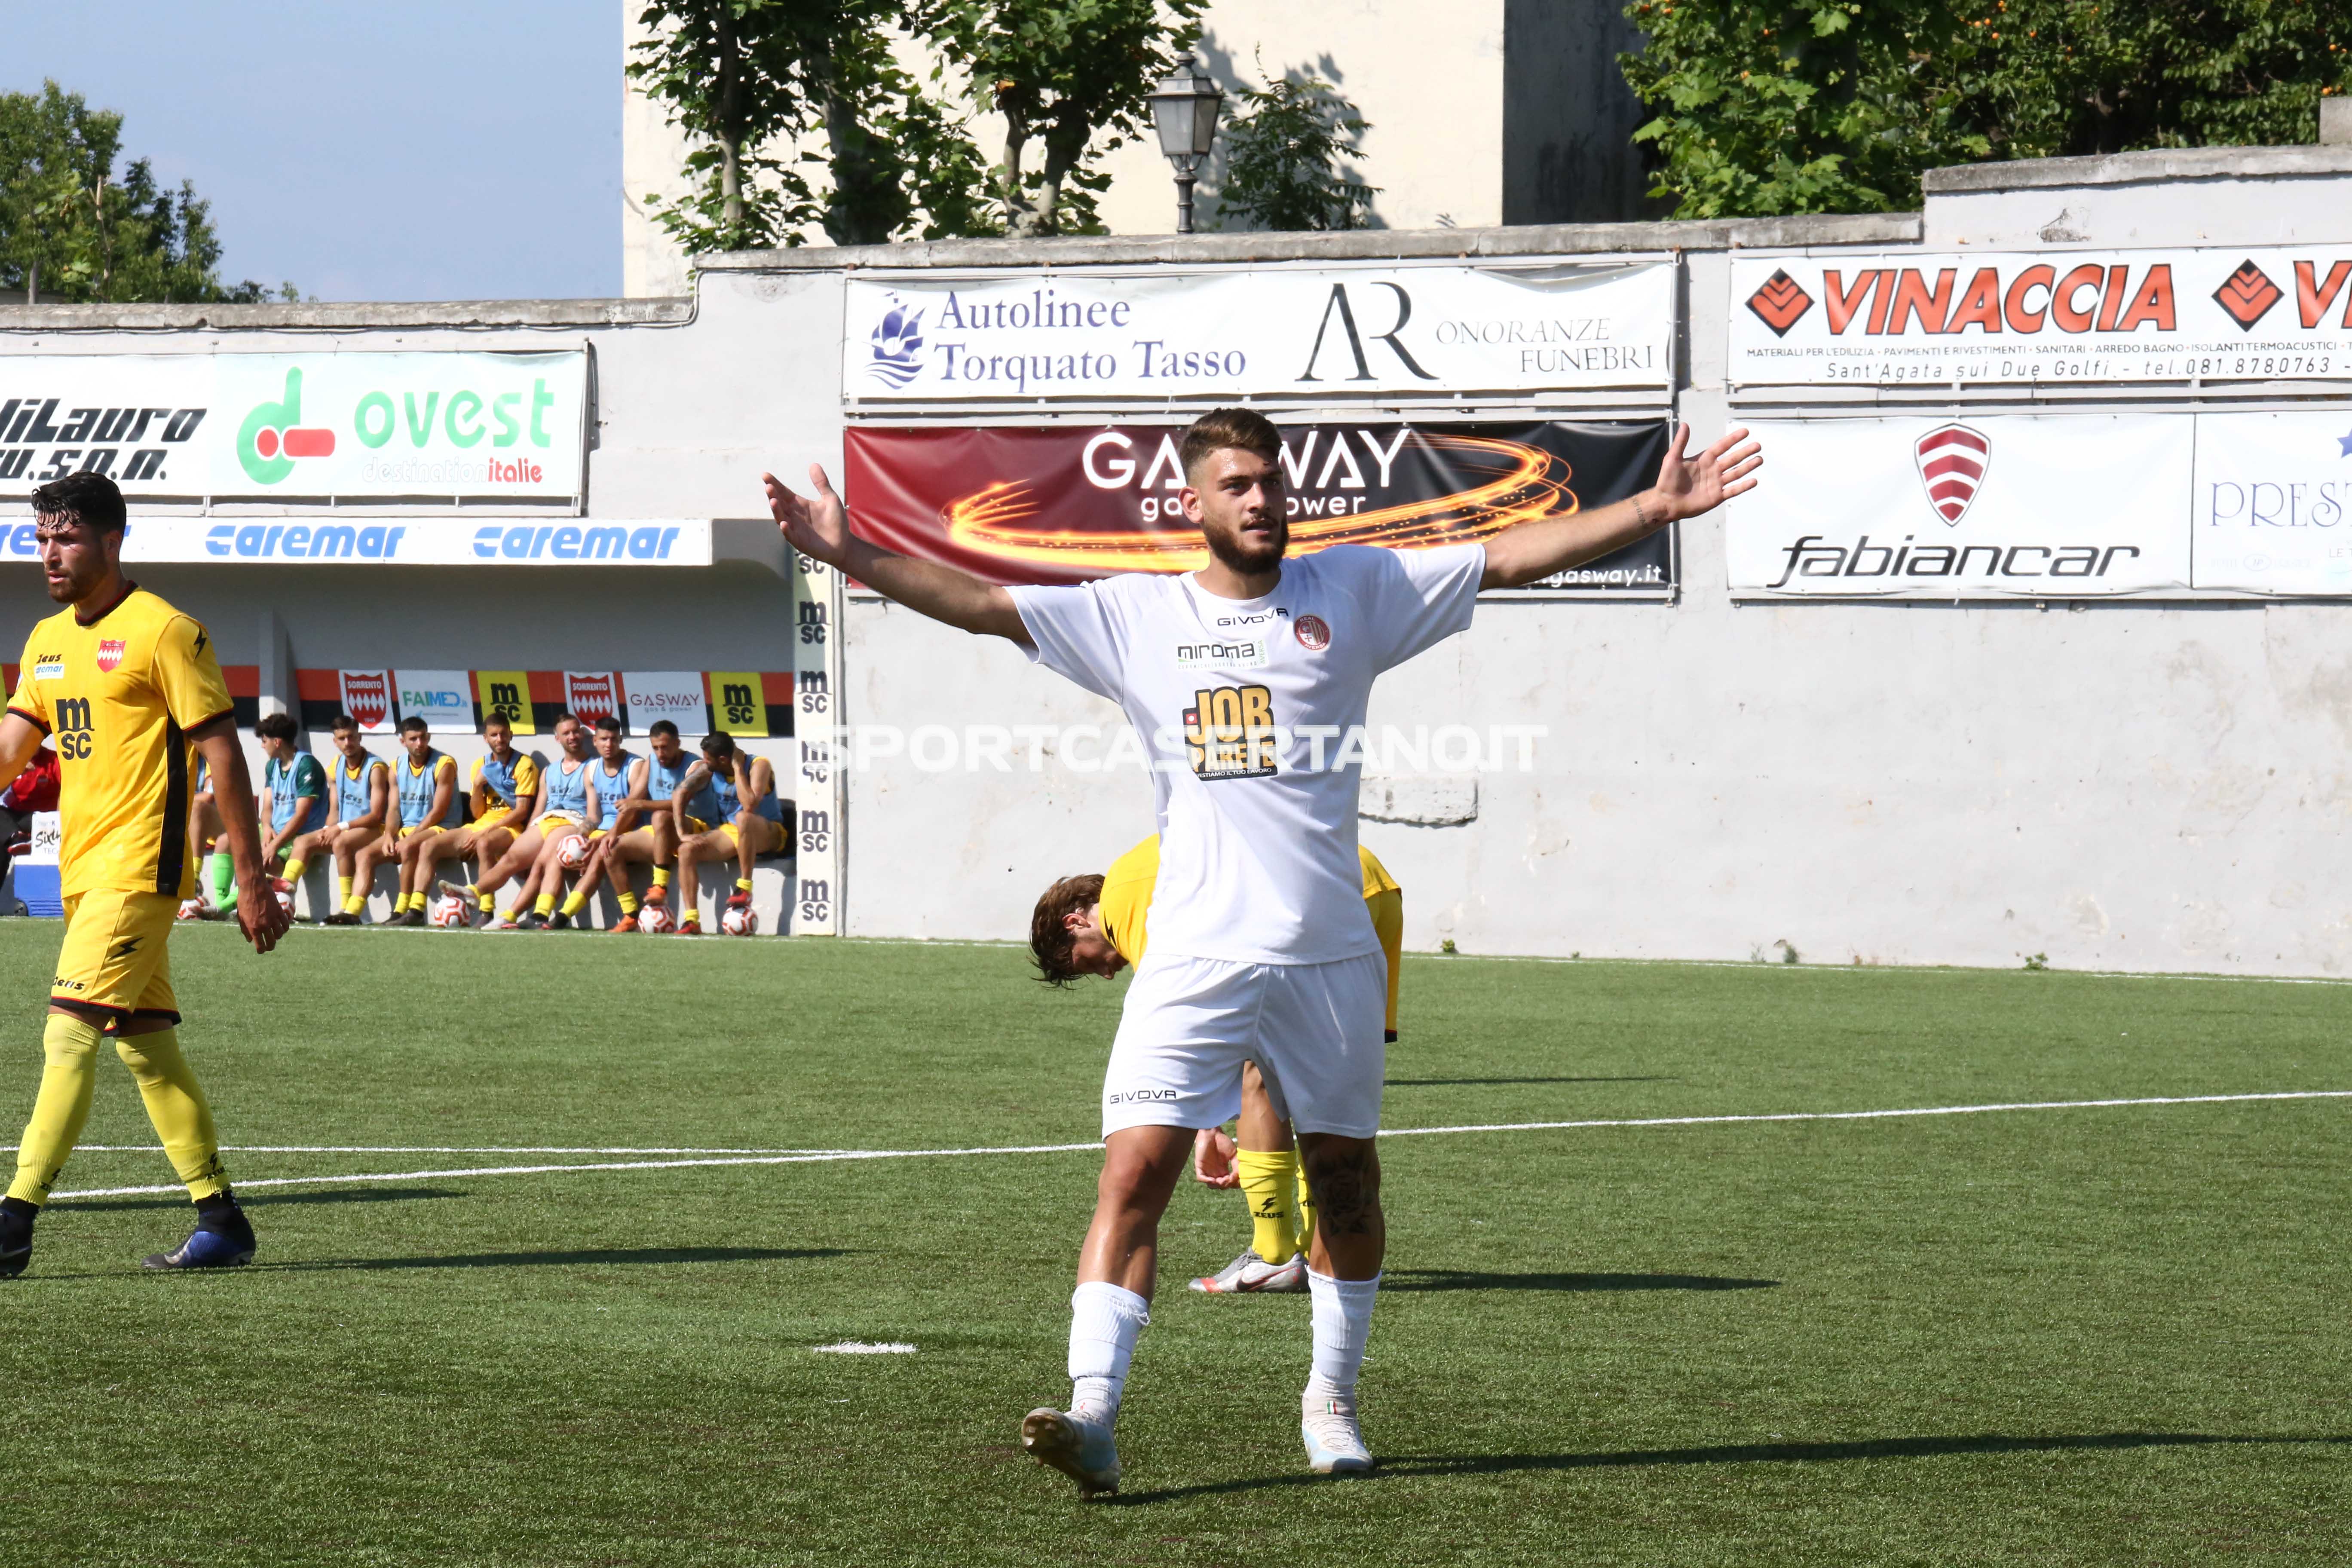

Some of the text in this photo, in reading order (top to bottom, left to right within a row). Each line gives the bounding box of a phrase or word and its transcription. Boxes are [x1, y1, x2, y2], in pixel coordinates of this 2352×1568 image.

[935, 289, 1131, 329] Autolinee
[1823, 264, 2177, 335] VINACCIA
[1436, 318, 1611, 344] ONORANZE
[1520, 345, 1653, 373] FUNEBRI
[1747, 342, 2337, 357] MATERIALI PER L'EDILIZIA PAVIMENTI E RIVESTIMENTI SANITARI ARREDO BAGNO ISOLANTI TERMOACUSTICI
[934, 340, 1246, 393] Torquato Tasso
[1827, 362, 1942, 383] Sant'Agata
[1956, 361, 1988, 377] sui
[2001, 361, 2040, 377] Due
[2055, 360, 2110, 376] Golfi
[354, 378, 554, 448] ovest
[1083, 429, 1411, 489] GAWAY
[1141, 495, 1366, 521] ga ower
[205, 525, 406, 557] caremar
[473, 527, 680, 559] caremar
[1766, 534, 2140, 588] fabiancar
[1217, 608, 1289, 626] GIVOVA
[347, 680, 382, 689] SORRENTO
[573, 682, 608, 691] SORRENTO
[630, 693, 700, 706] GASWAY
[1185, 687, 1273, 745] JOB
[1190, 740, 1275, 773] PARETE
[1110, 1090, 1177, 1104] GIVOVA
